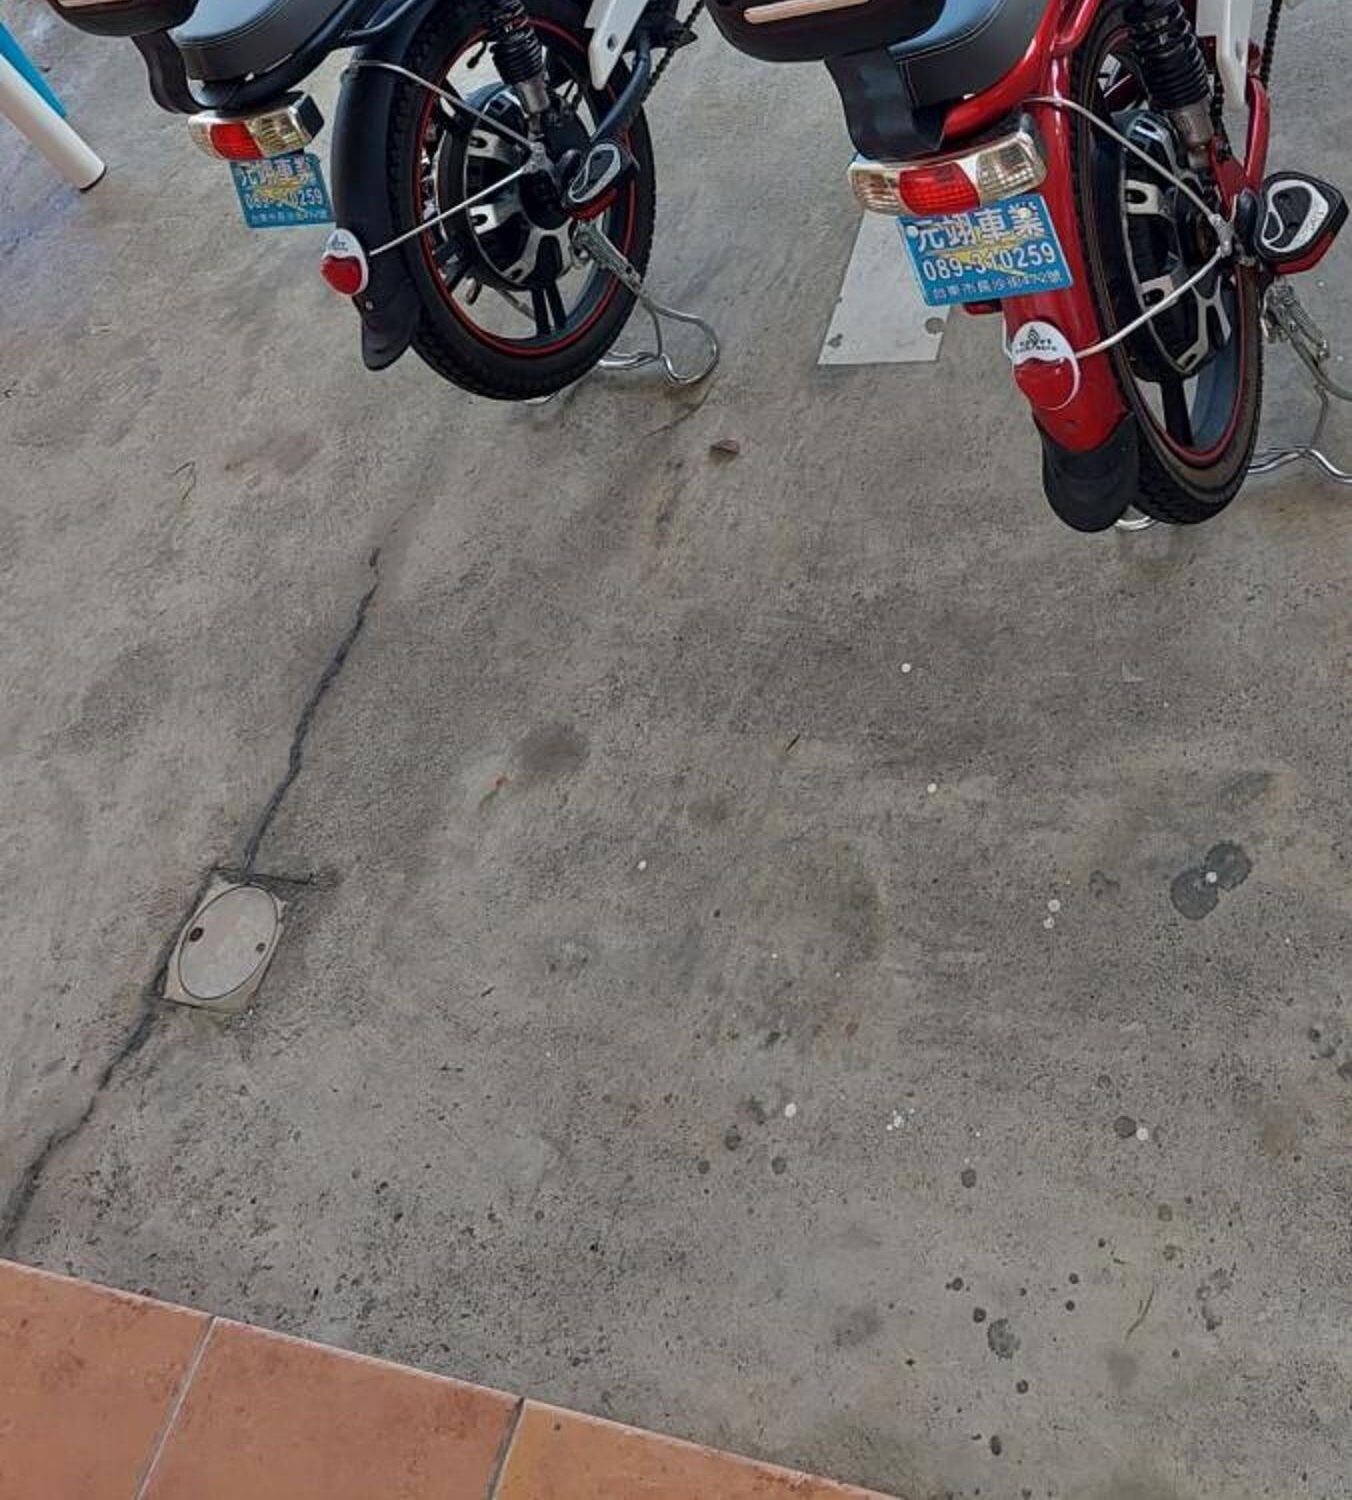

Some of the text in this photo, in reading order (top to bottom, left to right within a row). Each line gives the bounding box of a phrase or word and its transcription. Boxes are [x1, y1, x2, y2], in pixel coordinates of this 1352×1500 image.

[917, 201, 1045, 253] 元翊車業
[922, 241, 1056, 281] 089-310259
